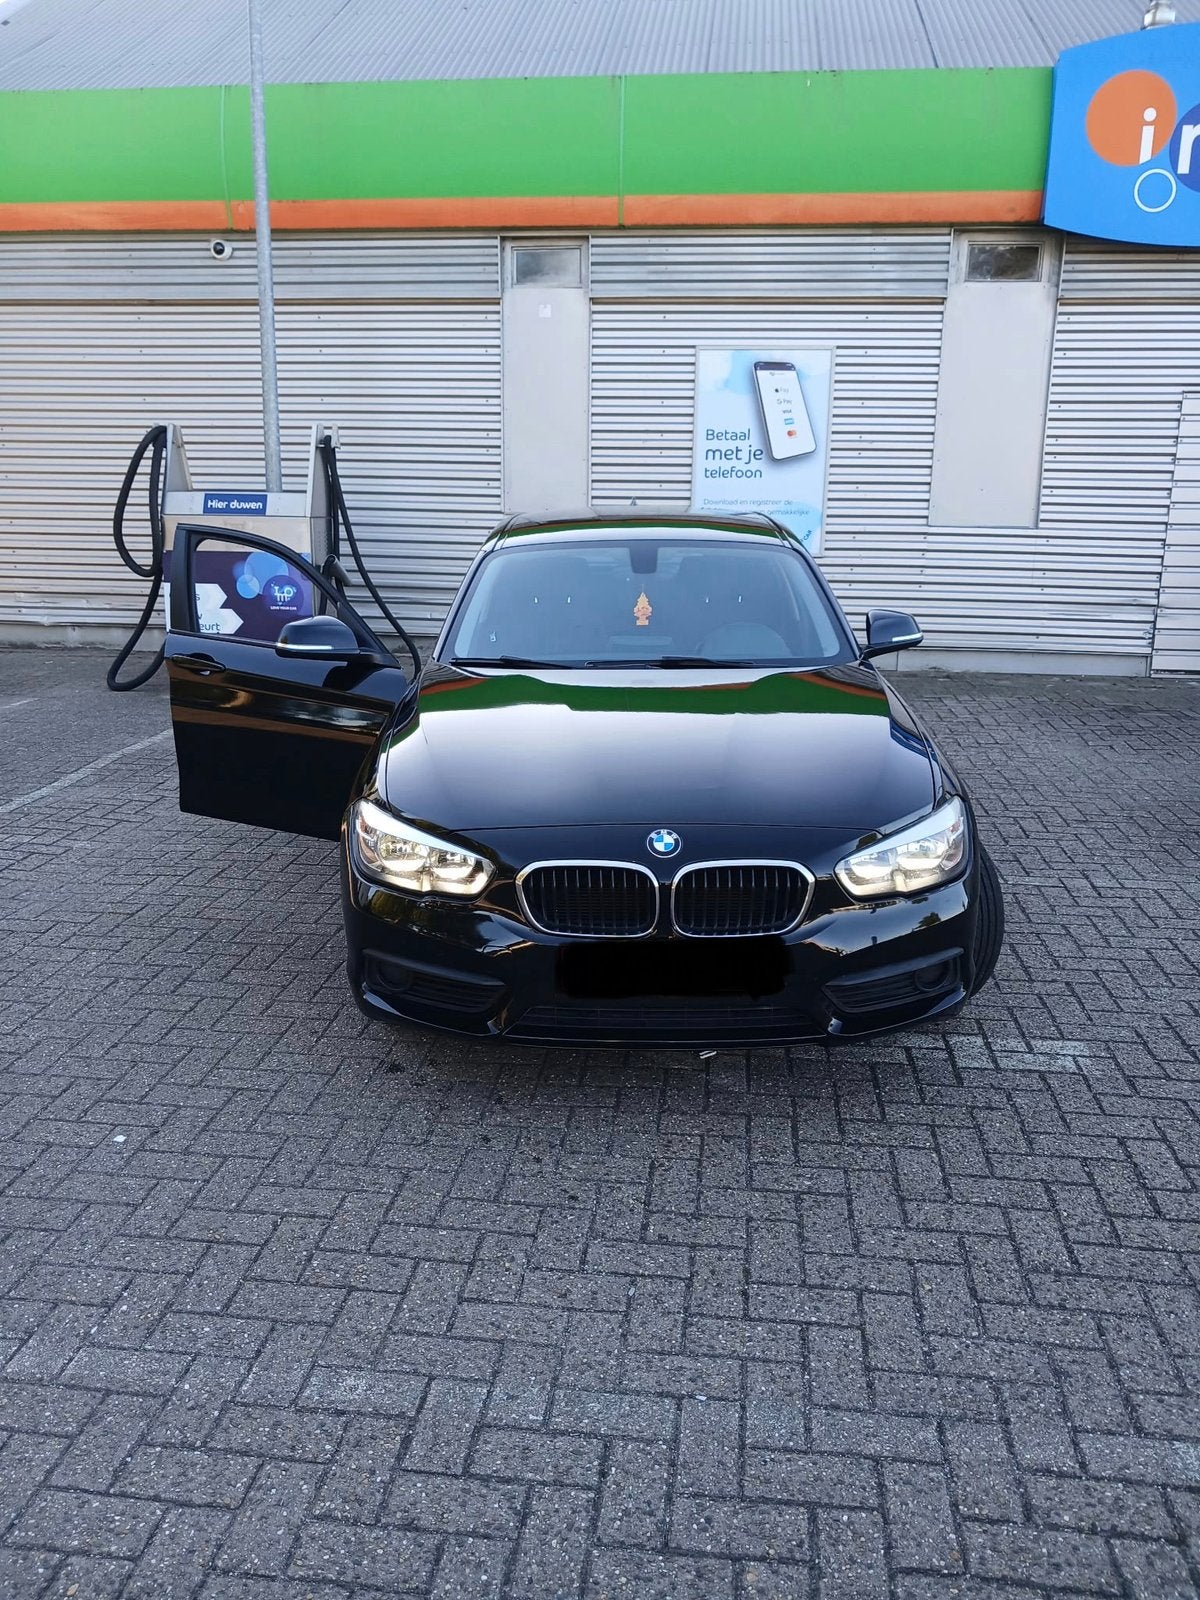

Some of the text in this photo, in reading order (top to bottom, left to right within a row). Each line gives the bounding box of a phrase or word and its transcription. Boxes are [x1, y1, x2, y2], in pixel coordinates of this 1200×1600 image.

[705, 428, 751, 441] Betaal
[705, 444, 764, 465] met je
[704, 466, 763, 479] telefoon
[207, 499, 263, 510] Hier duwen
[703, 498, 738, 506] Download
[200, 622, 221, 631] eurt
